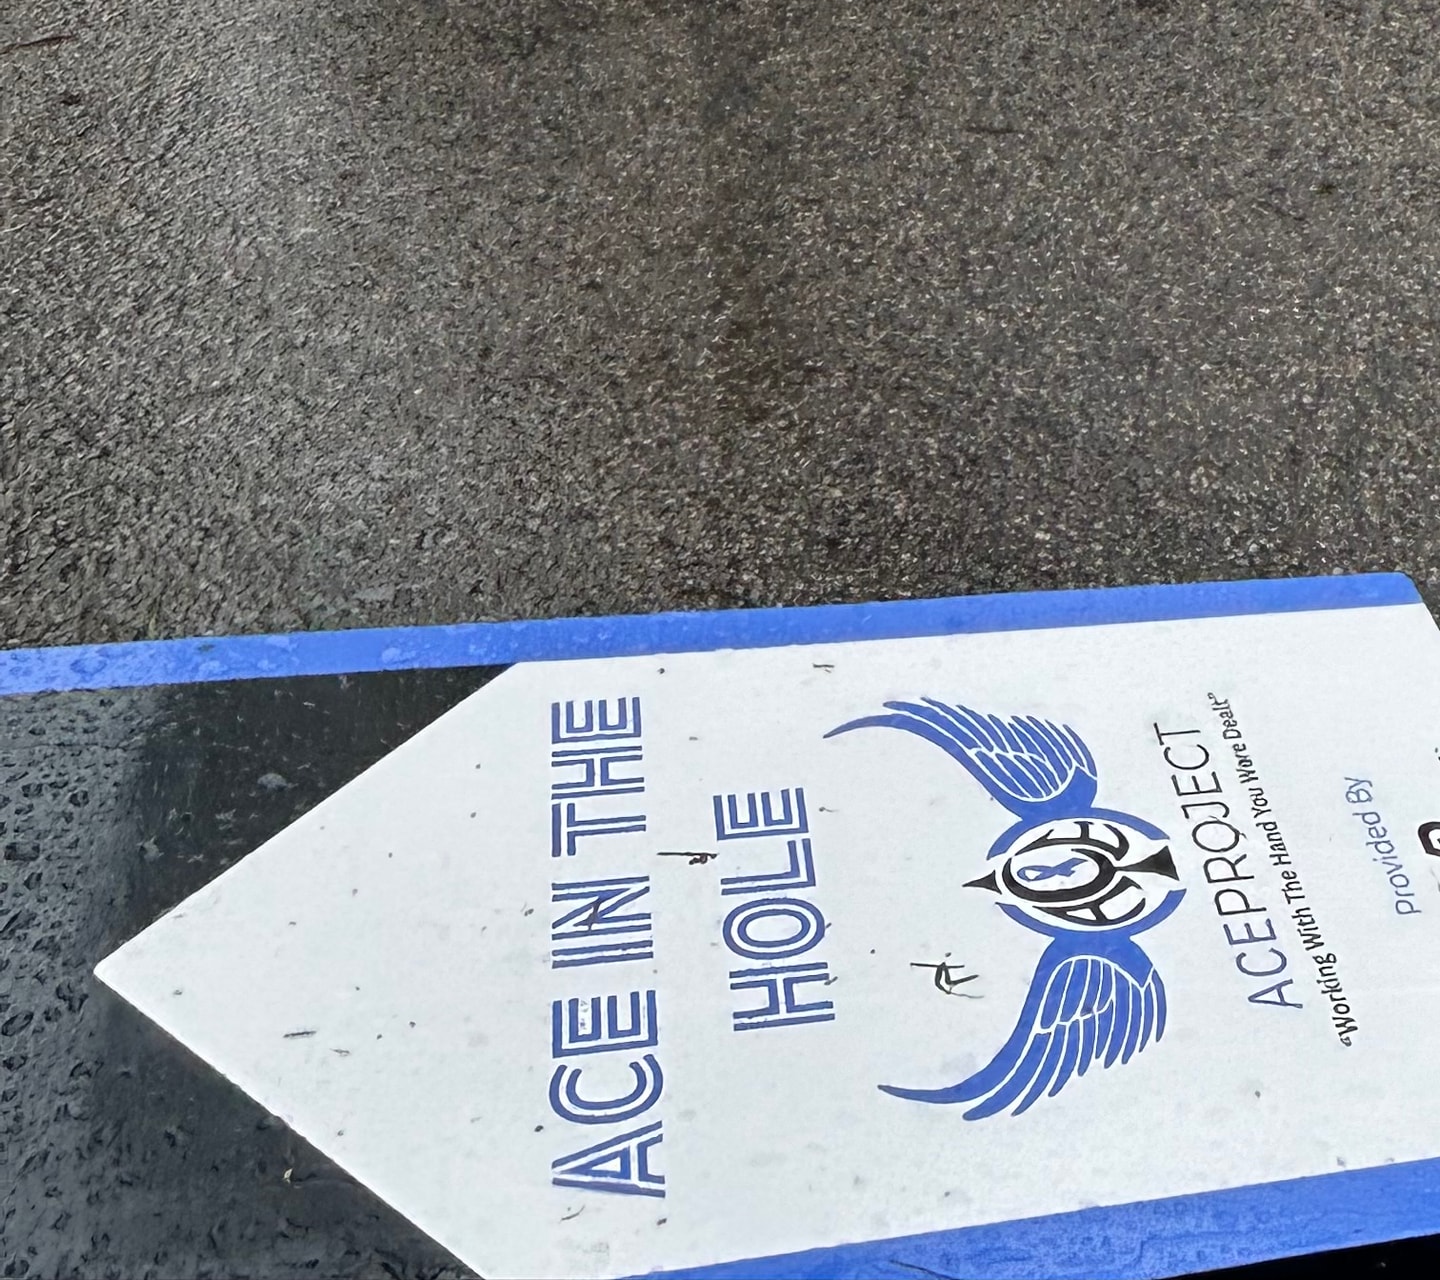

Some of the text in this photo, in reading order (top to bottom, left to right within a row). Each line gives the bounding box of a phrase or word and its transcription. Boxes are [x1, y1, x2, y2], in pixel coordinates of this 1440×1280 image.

[1249, 786, 1273, 821] You
[1255, 820, 1293, 871] Hand
[1344, 776, 1423, 916] Provided By
[713, 787, 835, 1031] HOLE
[1281, 869, 1306, 906] The
[549, 696, 666, 1198] ACE IN THE
[1291, 907, 1325, 952] With
